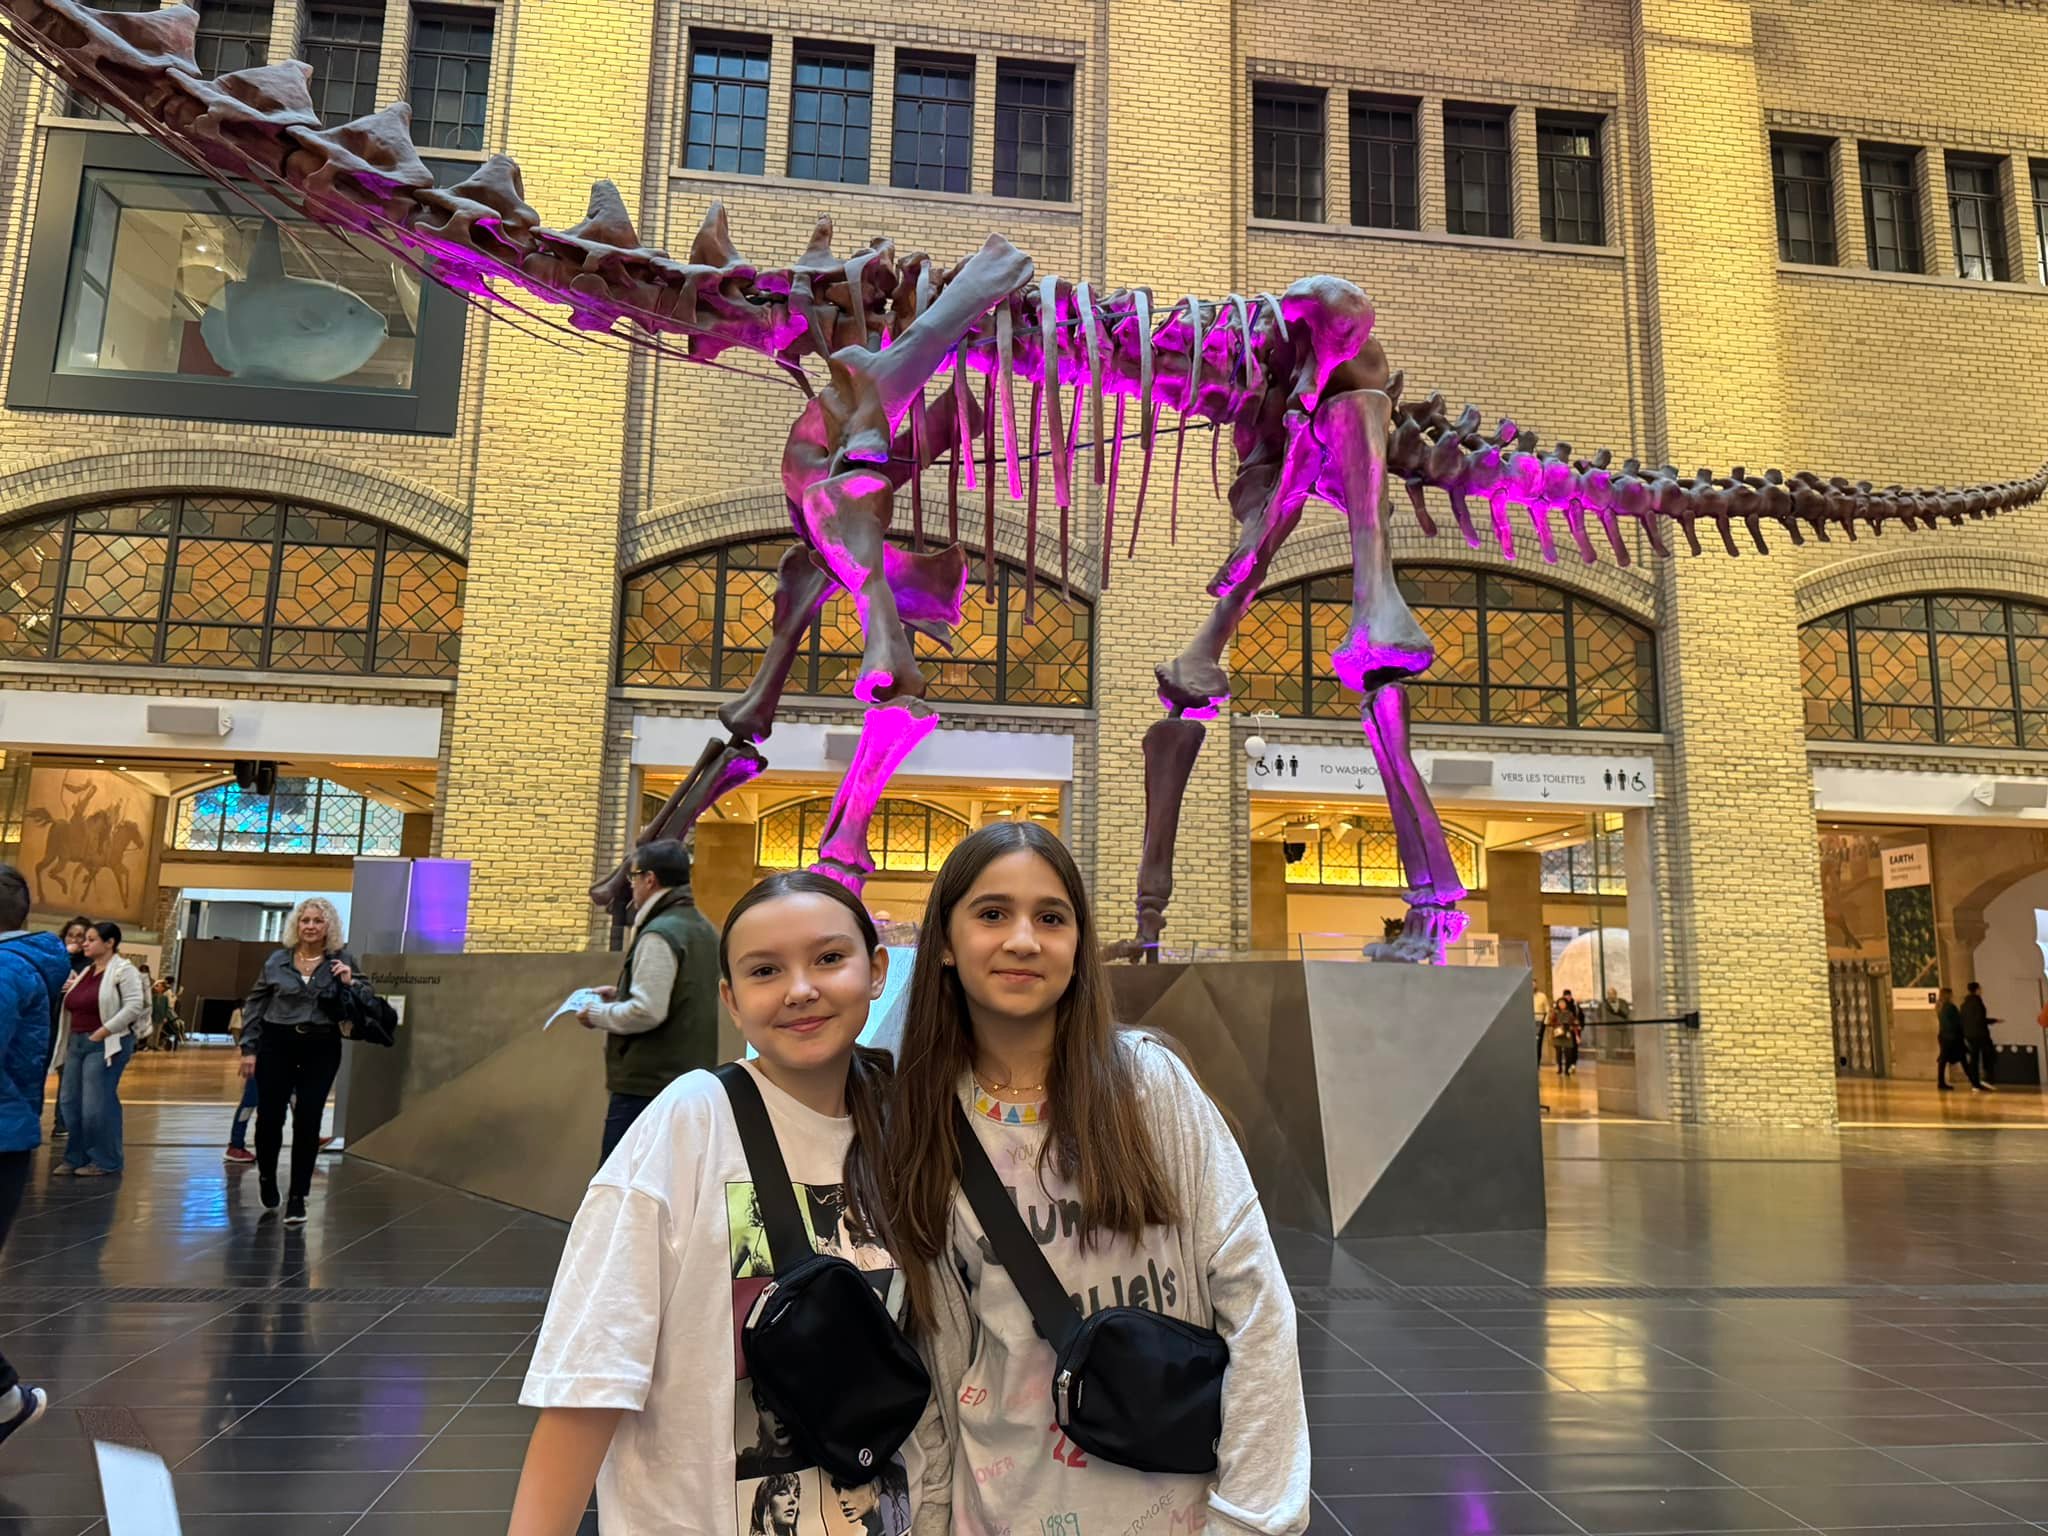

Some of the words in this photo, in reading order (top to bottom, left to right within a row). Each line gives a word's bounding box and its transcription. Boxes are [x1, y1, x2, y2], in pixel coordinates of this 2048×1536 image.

[1320, 764, 1333, 774] TO
[1335, 766, 1380, 776] WASHRO
[1501, 772, 1523, 782] VERS
[1525, 773, 1541, 783] LES
[1543, 774, 1586, 784] TOILETTES
[1889, 852, 1914, 865] EARTH
[1040, 1512, 1081, 1536] 1989
